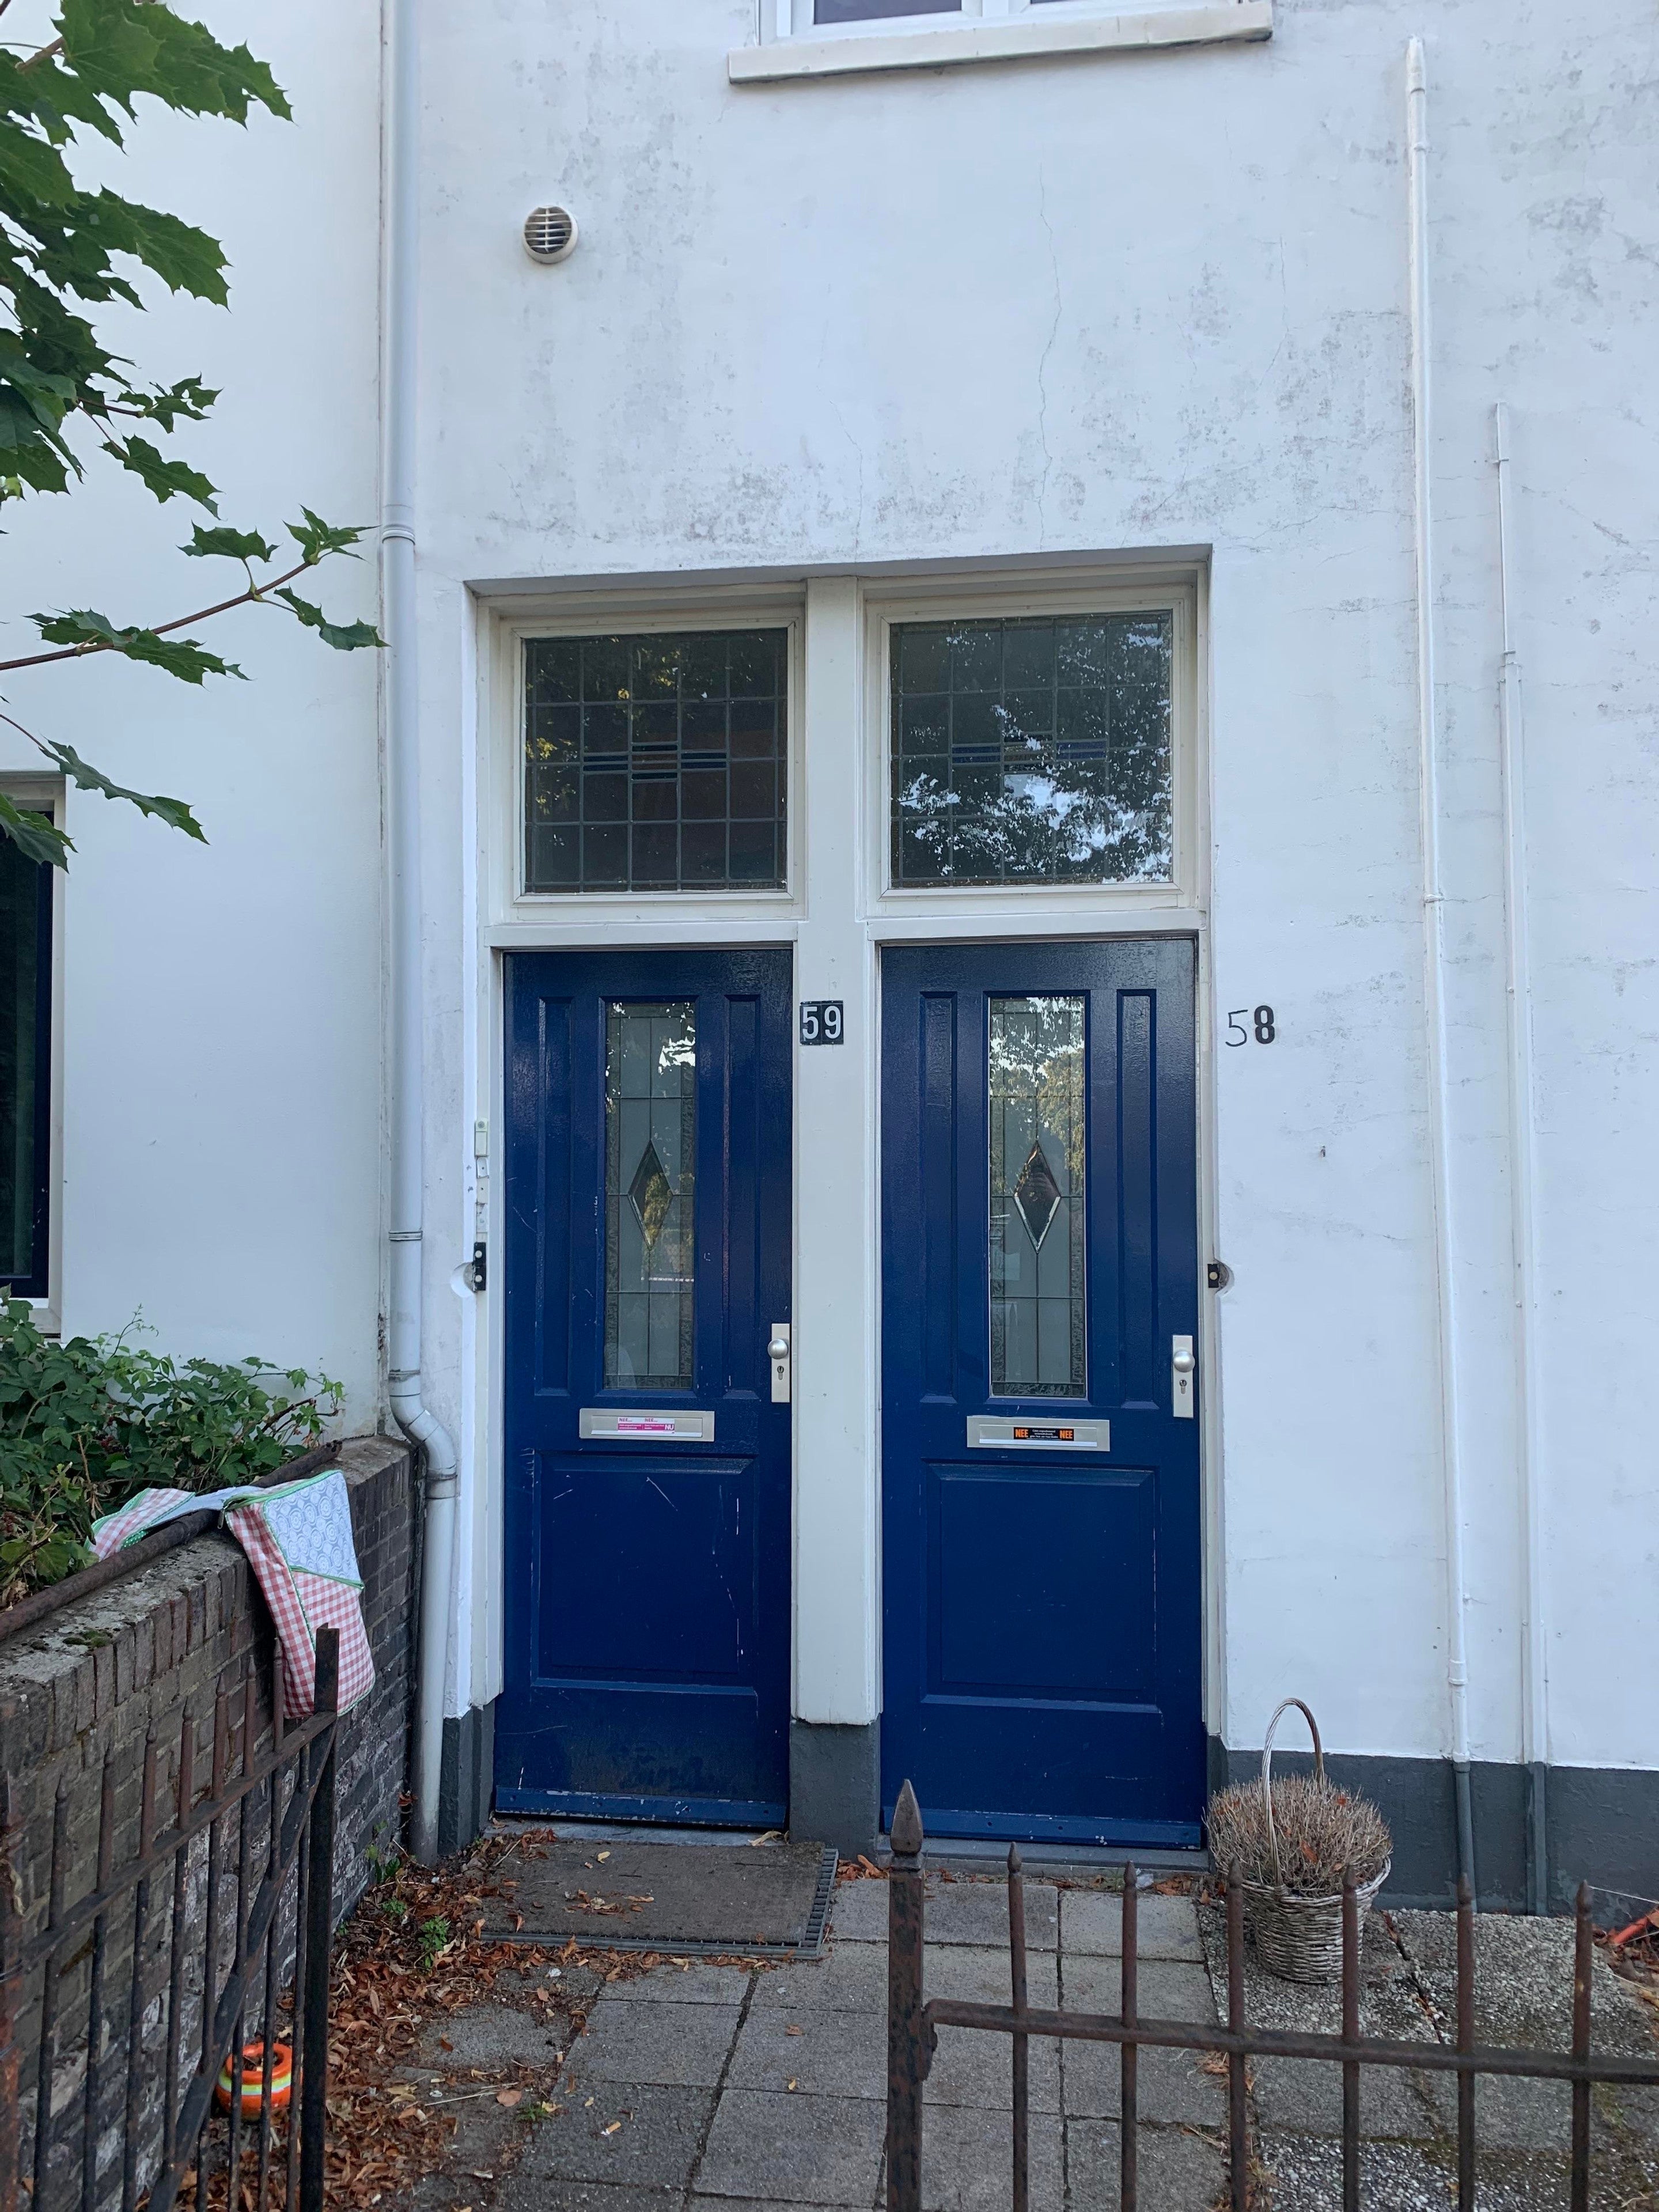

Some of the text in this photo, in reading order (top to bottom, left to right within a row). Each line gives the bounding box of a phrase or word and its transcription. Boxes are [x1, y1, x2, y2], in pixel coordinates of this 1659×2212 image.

[802, 1006, 842, 1039] 59
[1225, 1005, 1275, 1047] 58
[1015, 1429, 1028, 1438] NEE
[1059, 1430, 1073, 1439] NEE
